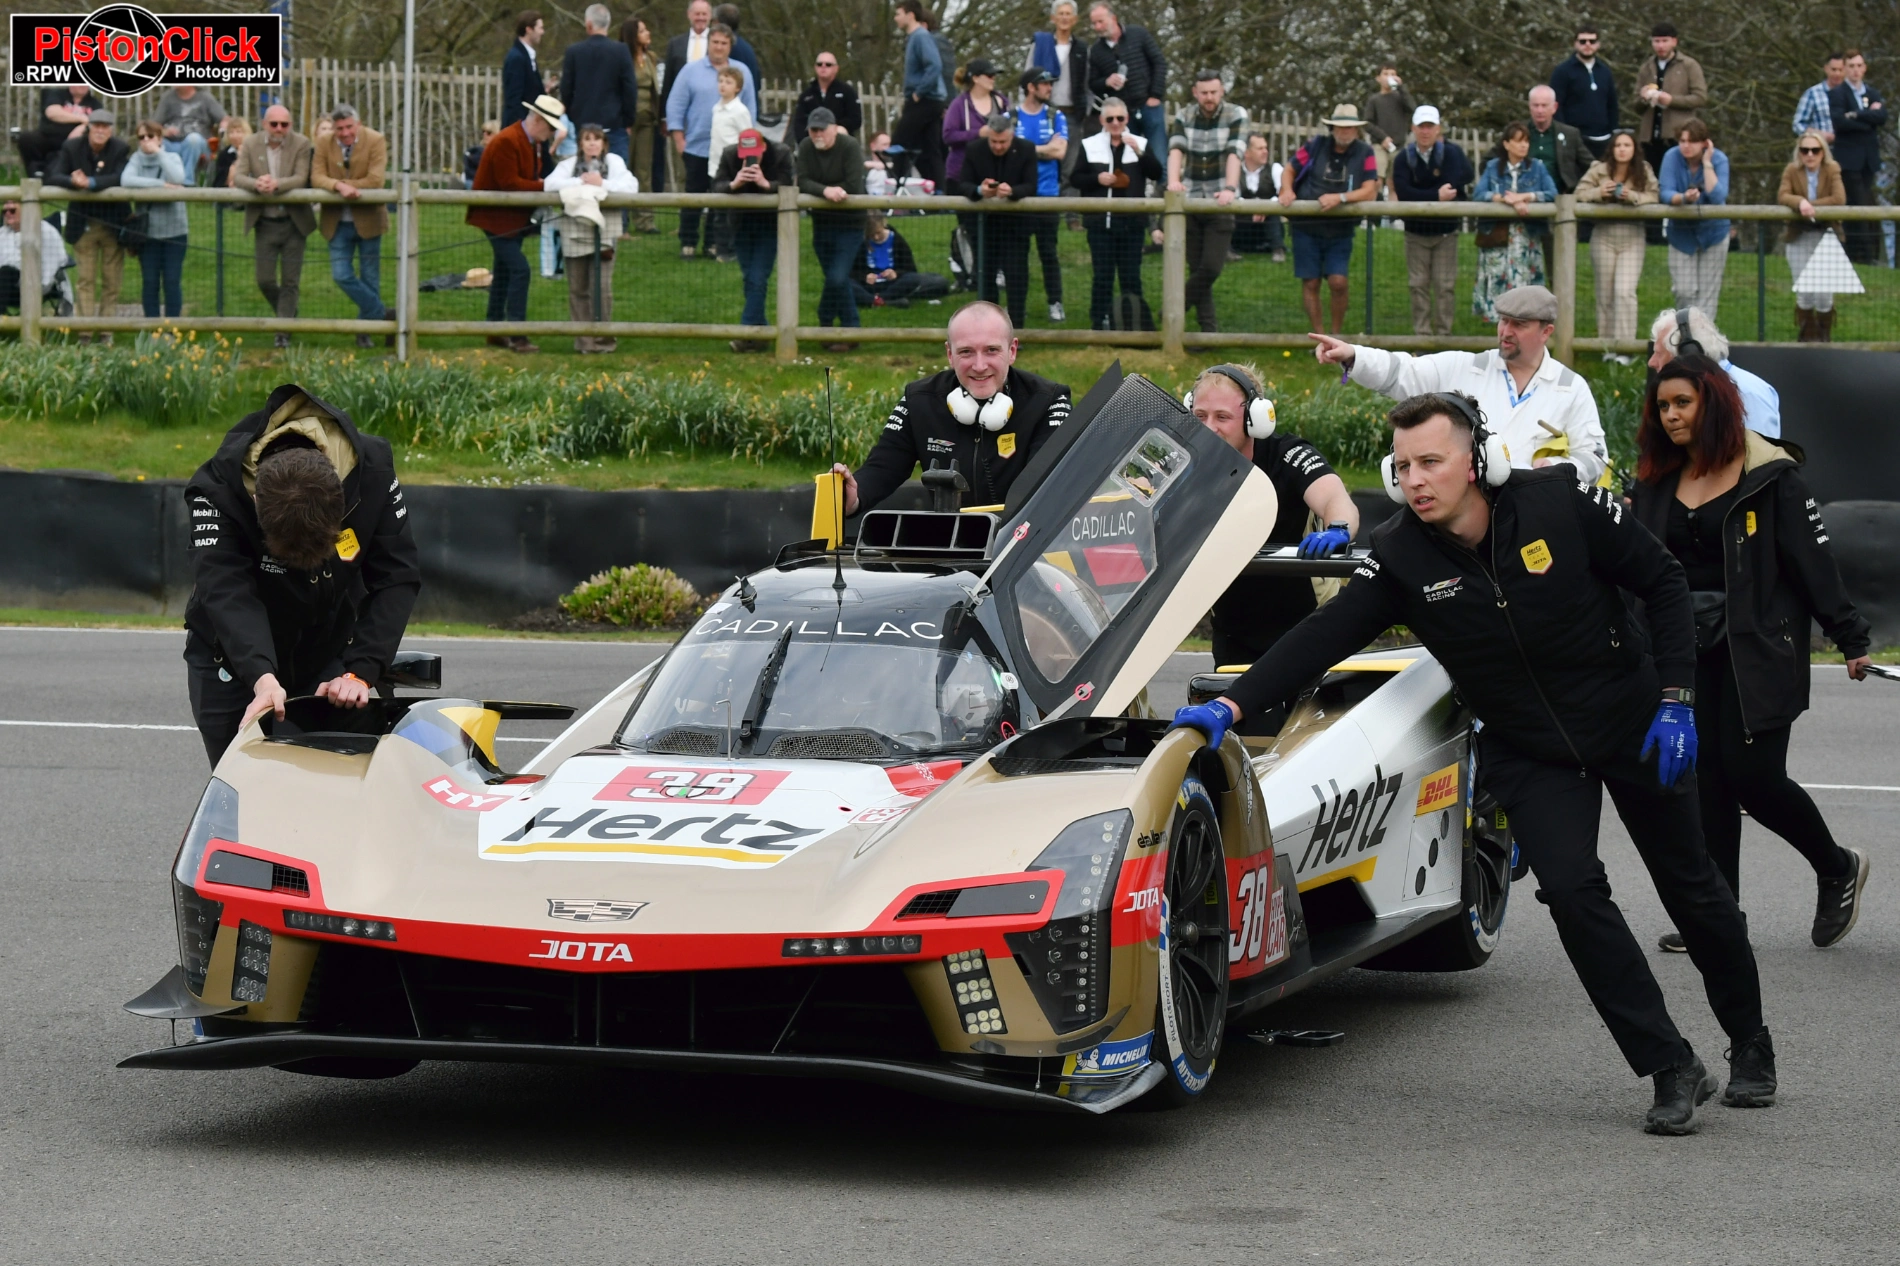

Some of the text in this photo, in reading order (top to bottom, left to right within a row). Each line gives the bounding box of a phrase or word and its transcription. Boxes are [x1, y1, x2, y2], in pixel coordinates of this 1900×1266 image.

[193, 509, 212, 518] Mobil
[193, 523, 220, 532] JOTA
[1071, 511, 1136, 541] CADILLAC
[1527, 545, 1542, 556] Hertz
[1426, 585, 1464, 599] CADILLAC
[1427, 591, 1456, 602] RACING
[695, 618, 944, 640] CADILLAC
[1676, 731, 1686, 758] HyFlex
[1421, 774, 1458, 804] DHL
[501, 806, 826, 852] Hertz
[1296, 763, 1404, 875] Hertz
[1123, 887, 1159, 913] JOTA
[1229, 866, 1268, 963] 38
[528, 940, 634, 963] JOTA
[1102, 1044, 1149, 1067] MICHELIN
